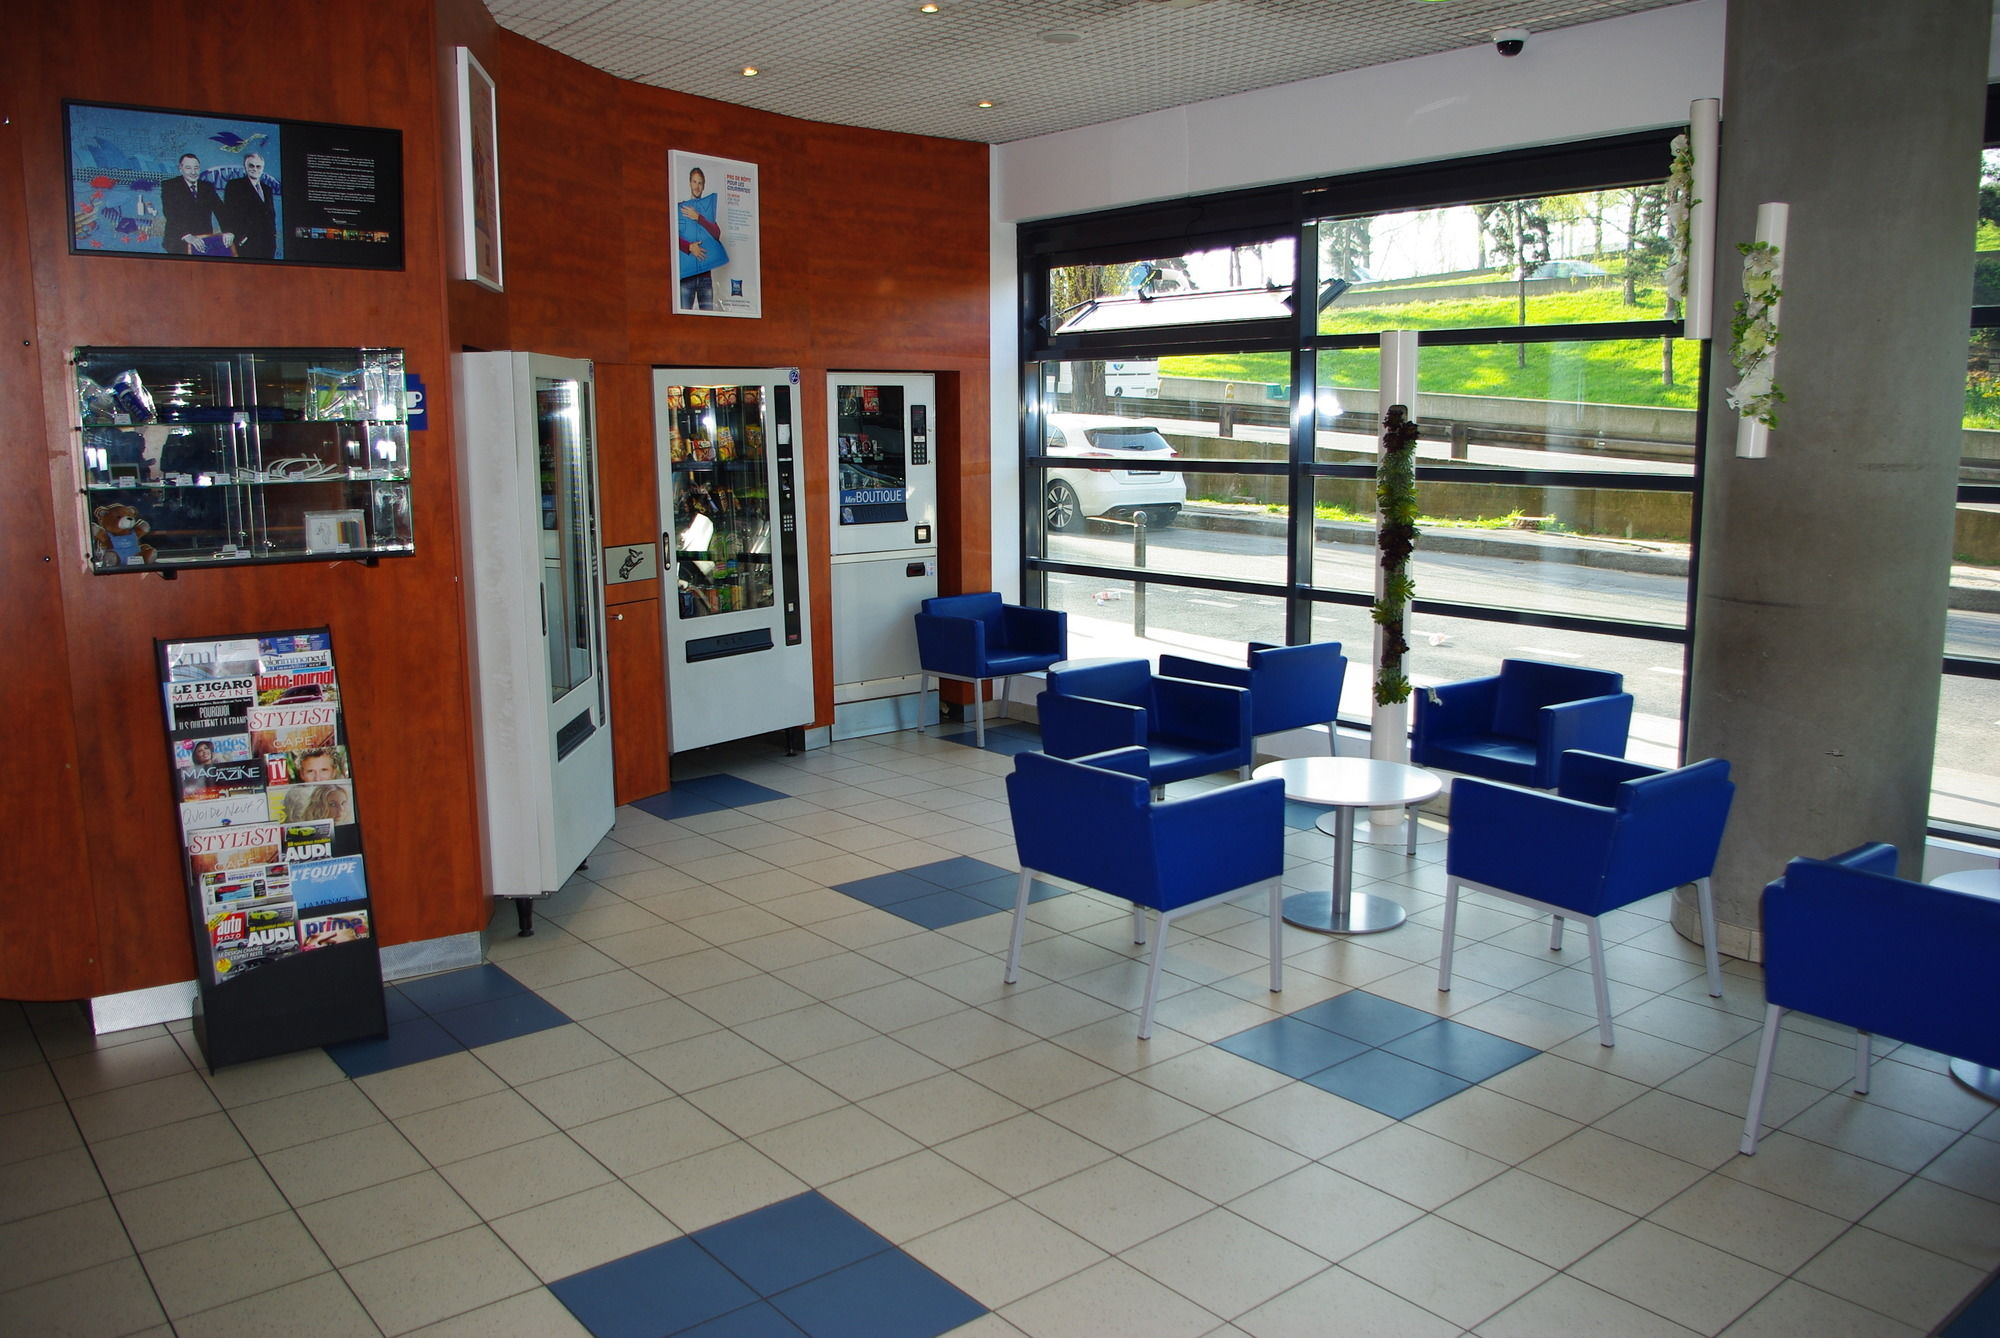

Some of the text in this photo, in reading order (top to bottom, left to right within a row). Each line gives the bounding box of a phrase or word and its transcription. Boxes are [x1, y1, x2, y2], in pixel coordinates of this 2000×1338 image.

[856, 490, 902, 503] BOUTIQUE
[172, 688, 254, 701] MAGAZINE
[174, 679, 253, 694] LE FIGARO
[199, 705, 230, 718] POURQUOI
[249, 707, 335, 729] STYLIST
[182, 765, 260, 782] MAGAZINE
[269, 759, 287, 779] TV
[189, 827, 278, 854] STYLIST
[285, 842, 332, 862] AUDI
[217, 916, 242, 936] auto
[217, 933, 241, 942] MOTO
[247, 926, 296, 948] AUDI
